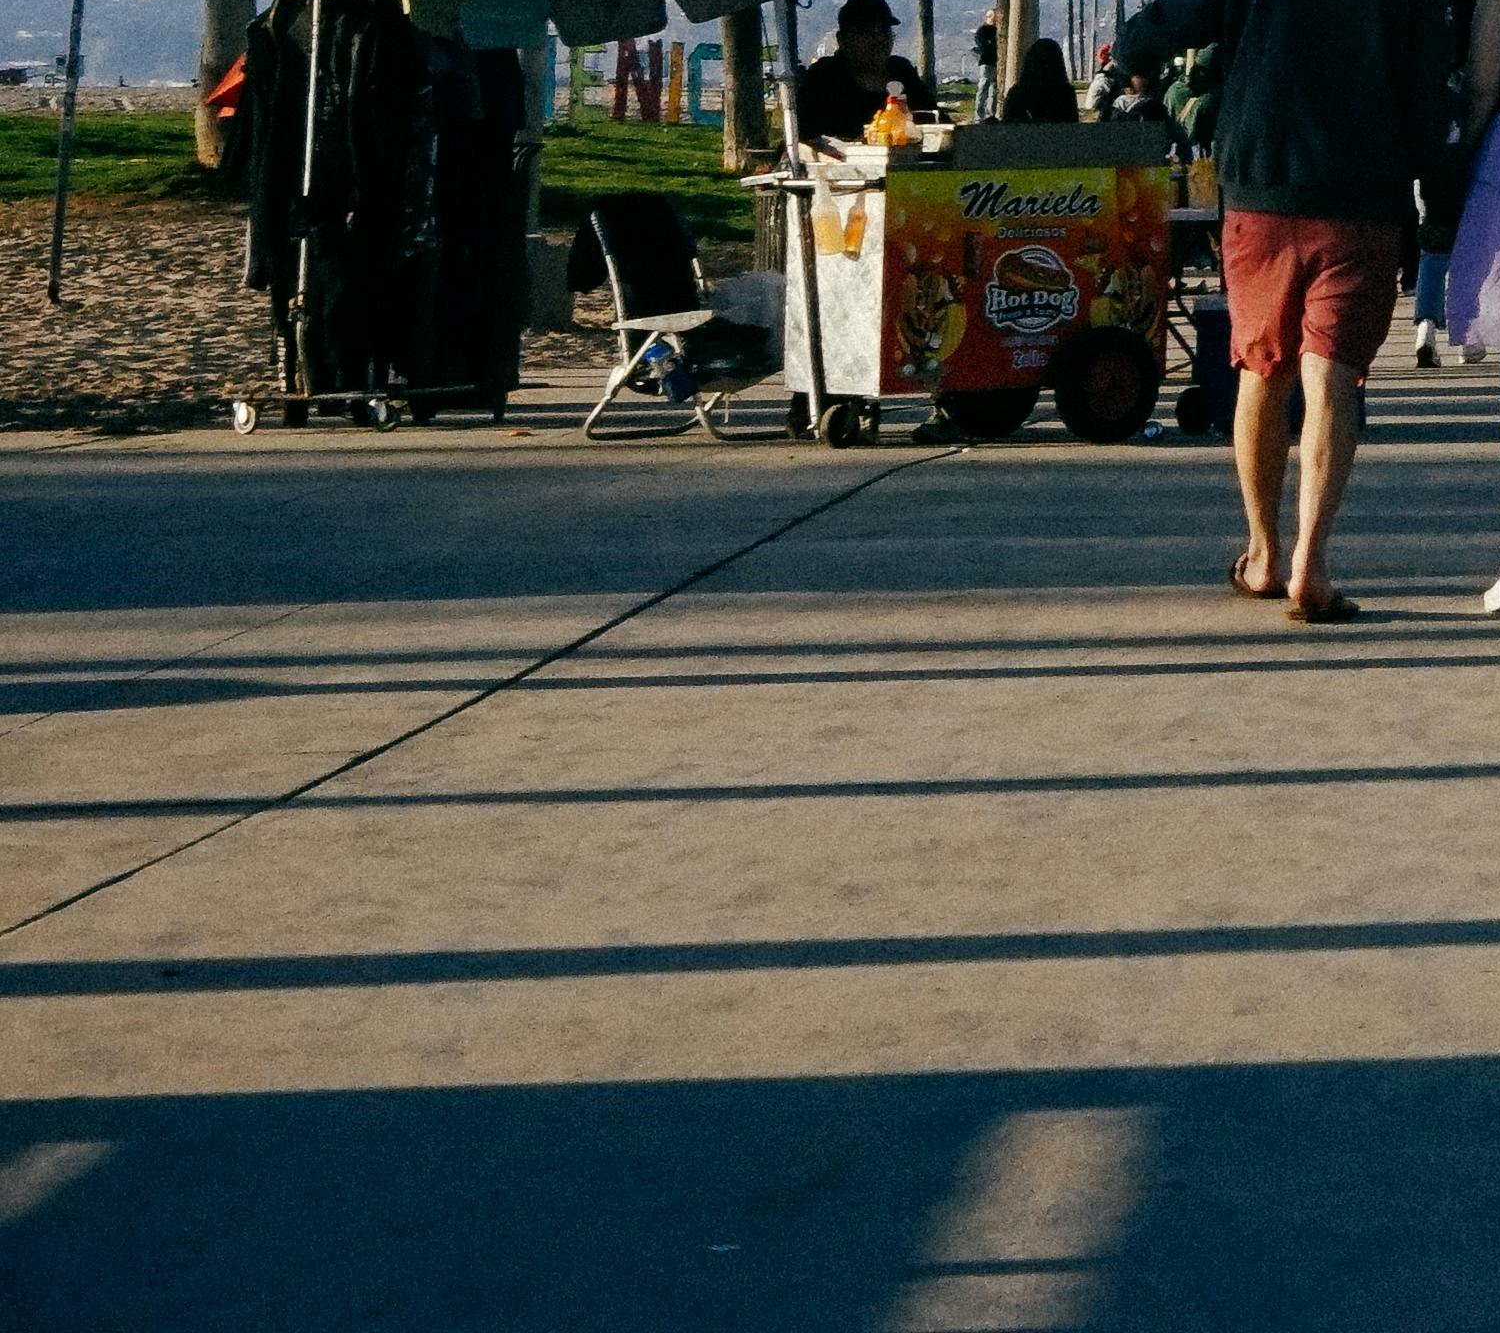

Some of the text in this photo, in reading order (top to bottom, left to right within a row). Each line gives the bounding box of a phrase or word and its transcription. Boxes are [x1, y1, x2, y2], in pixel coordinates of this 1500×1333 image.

[959, 181, 1101, 219] Mariela
[990, 288, 1075, 314] Hot Dog
